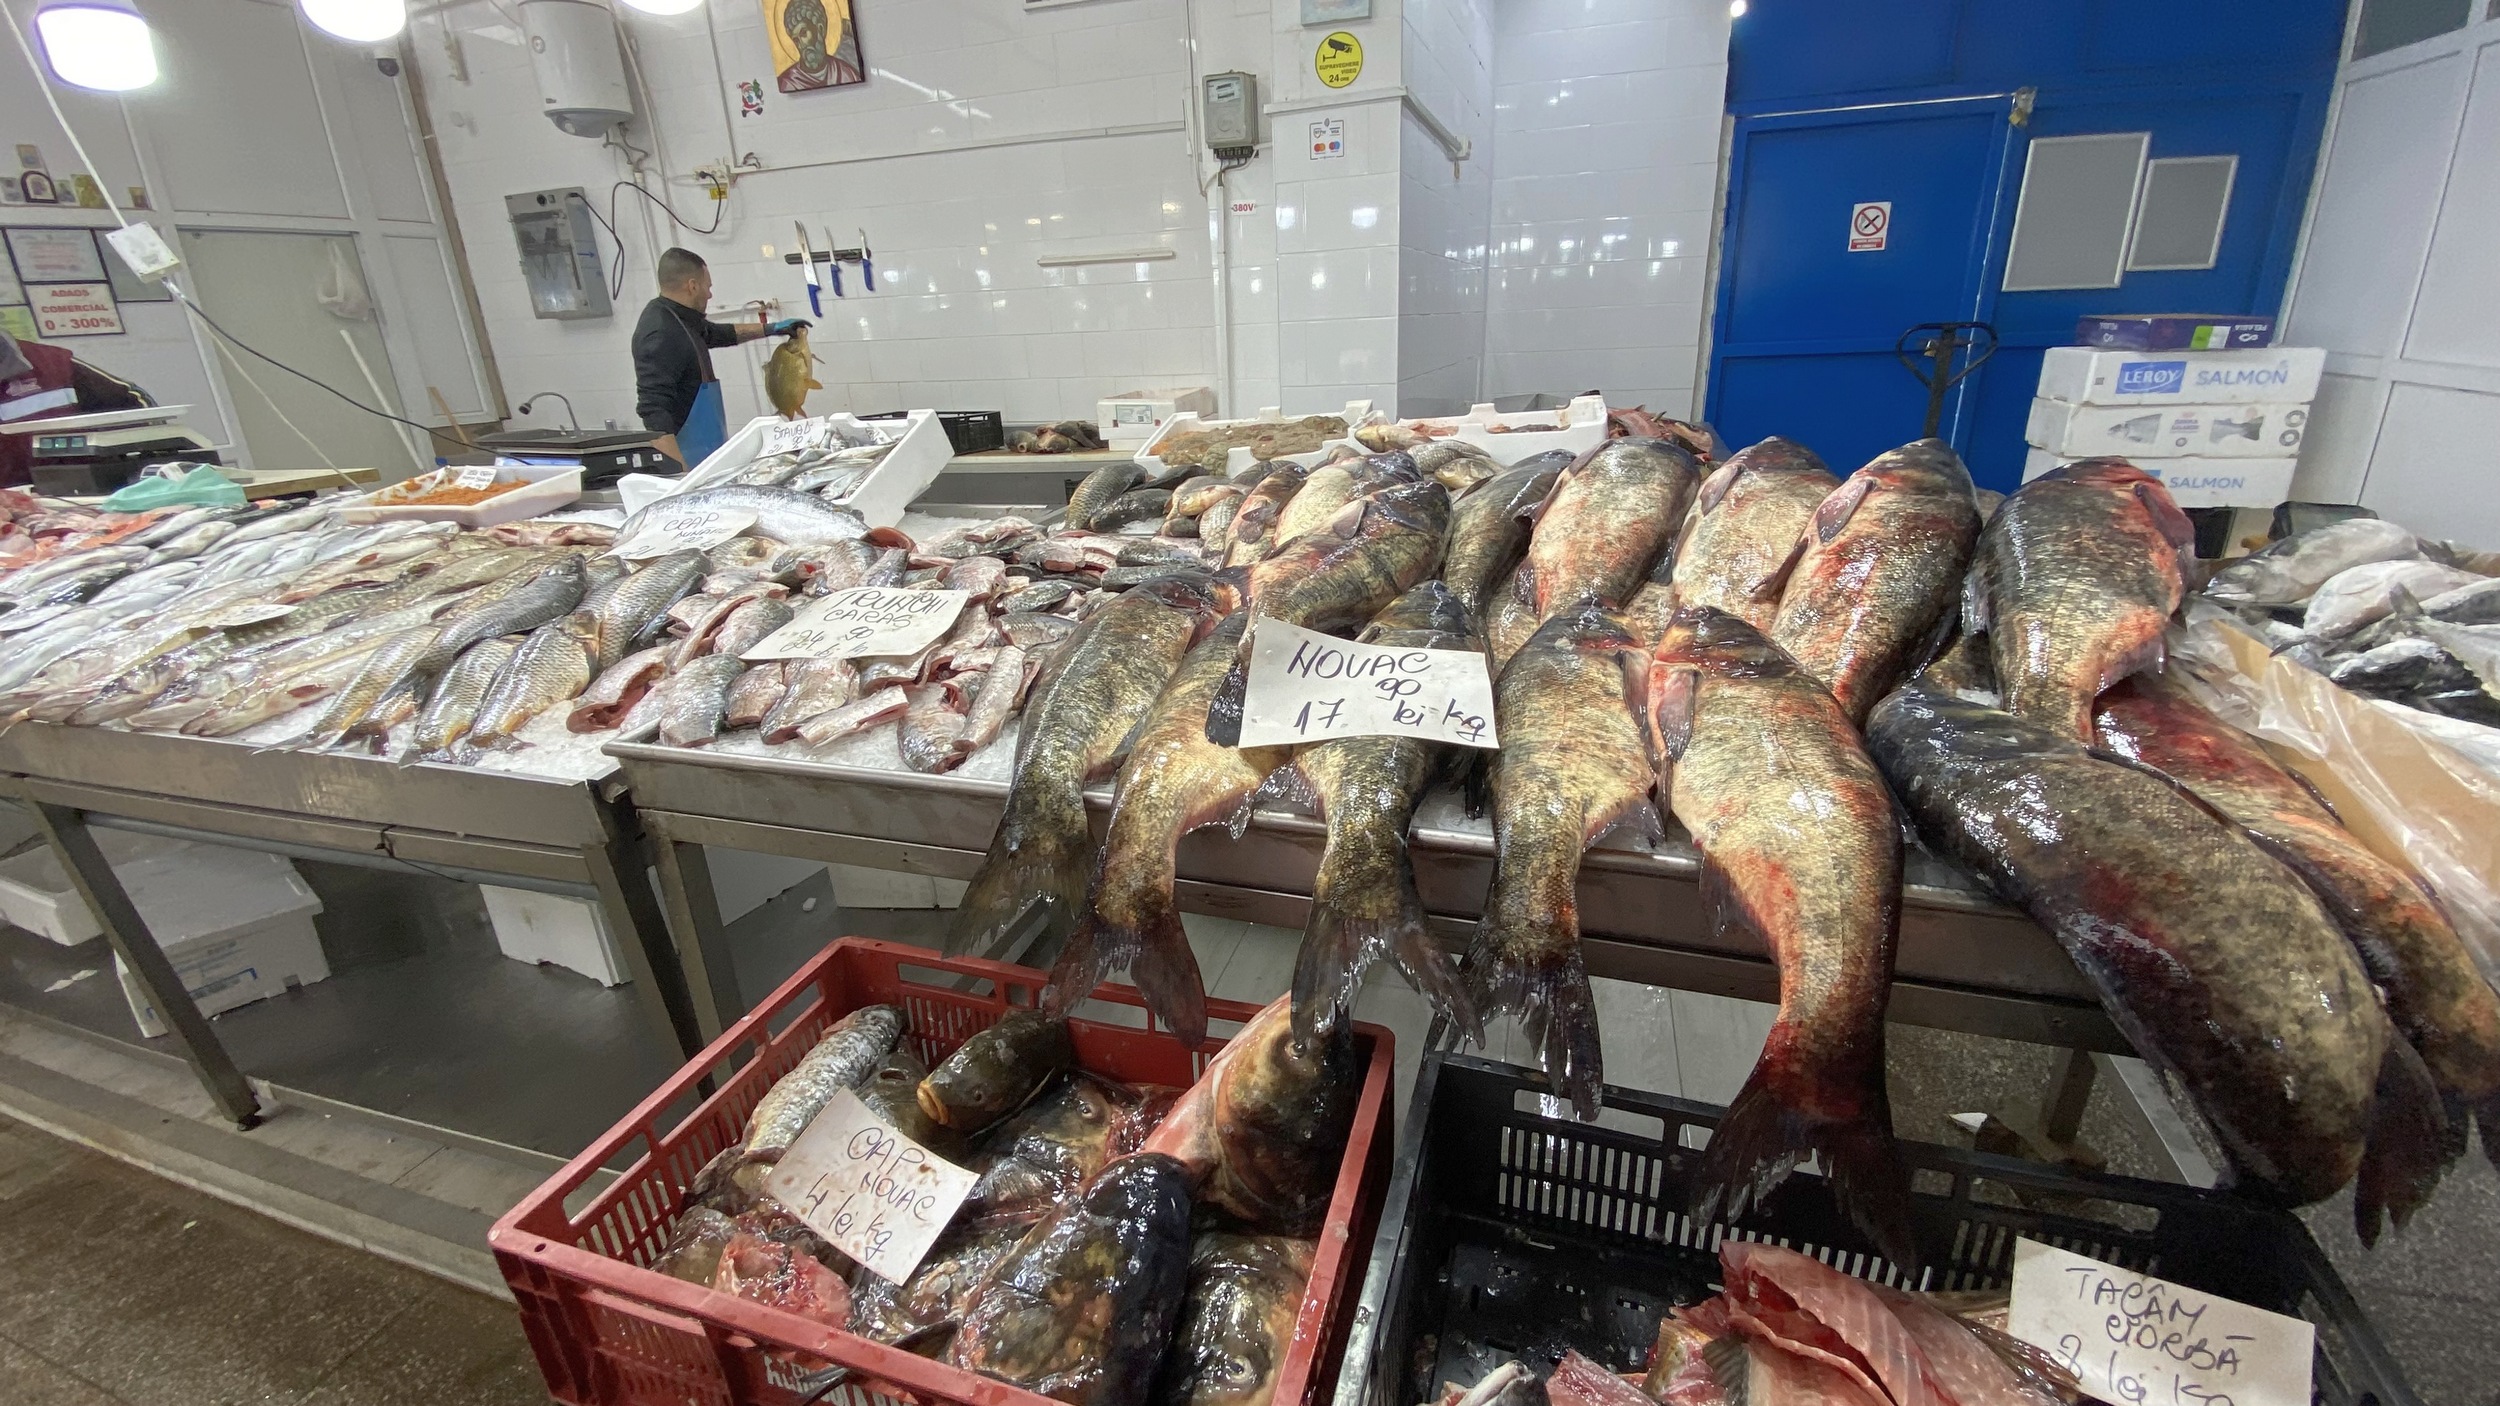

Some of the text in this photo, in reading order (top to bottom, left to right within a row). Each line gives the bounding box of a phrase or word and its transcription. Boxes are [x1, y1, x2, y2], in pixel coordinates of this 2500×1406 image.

[1329, 74, 1340, 82] 24
[51, 289, 90, 297] ADAOS
[41, 304, 109, 313] COMERCIAL
[44, 320, 56, 330] 0
[70, 317, 115, 329] 300%
[2123, 368, 2288, 386] LERØY SALMON
[2169, 476, 2245, 489] SALMON
[823, 609, 913, 628] CARAS
[1287, 640, 1431, 679] NOVAC
[1294, 677, 1487, 742] 17 90 lei kg
[847, 1127, 926, 1176] CAP
[861, 1172, 936, 1222] NOVAC
[806, 1172, 893, 1262] 4 lei kg
